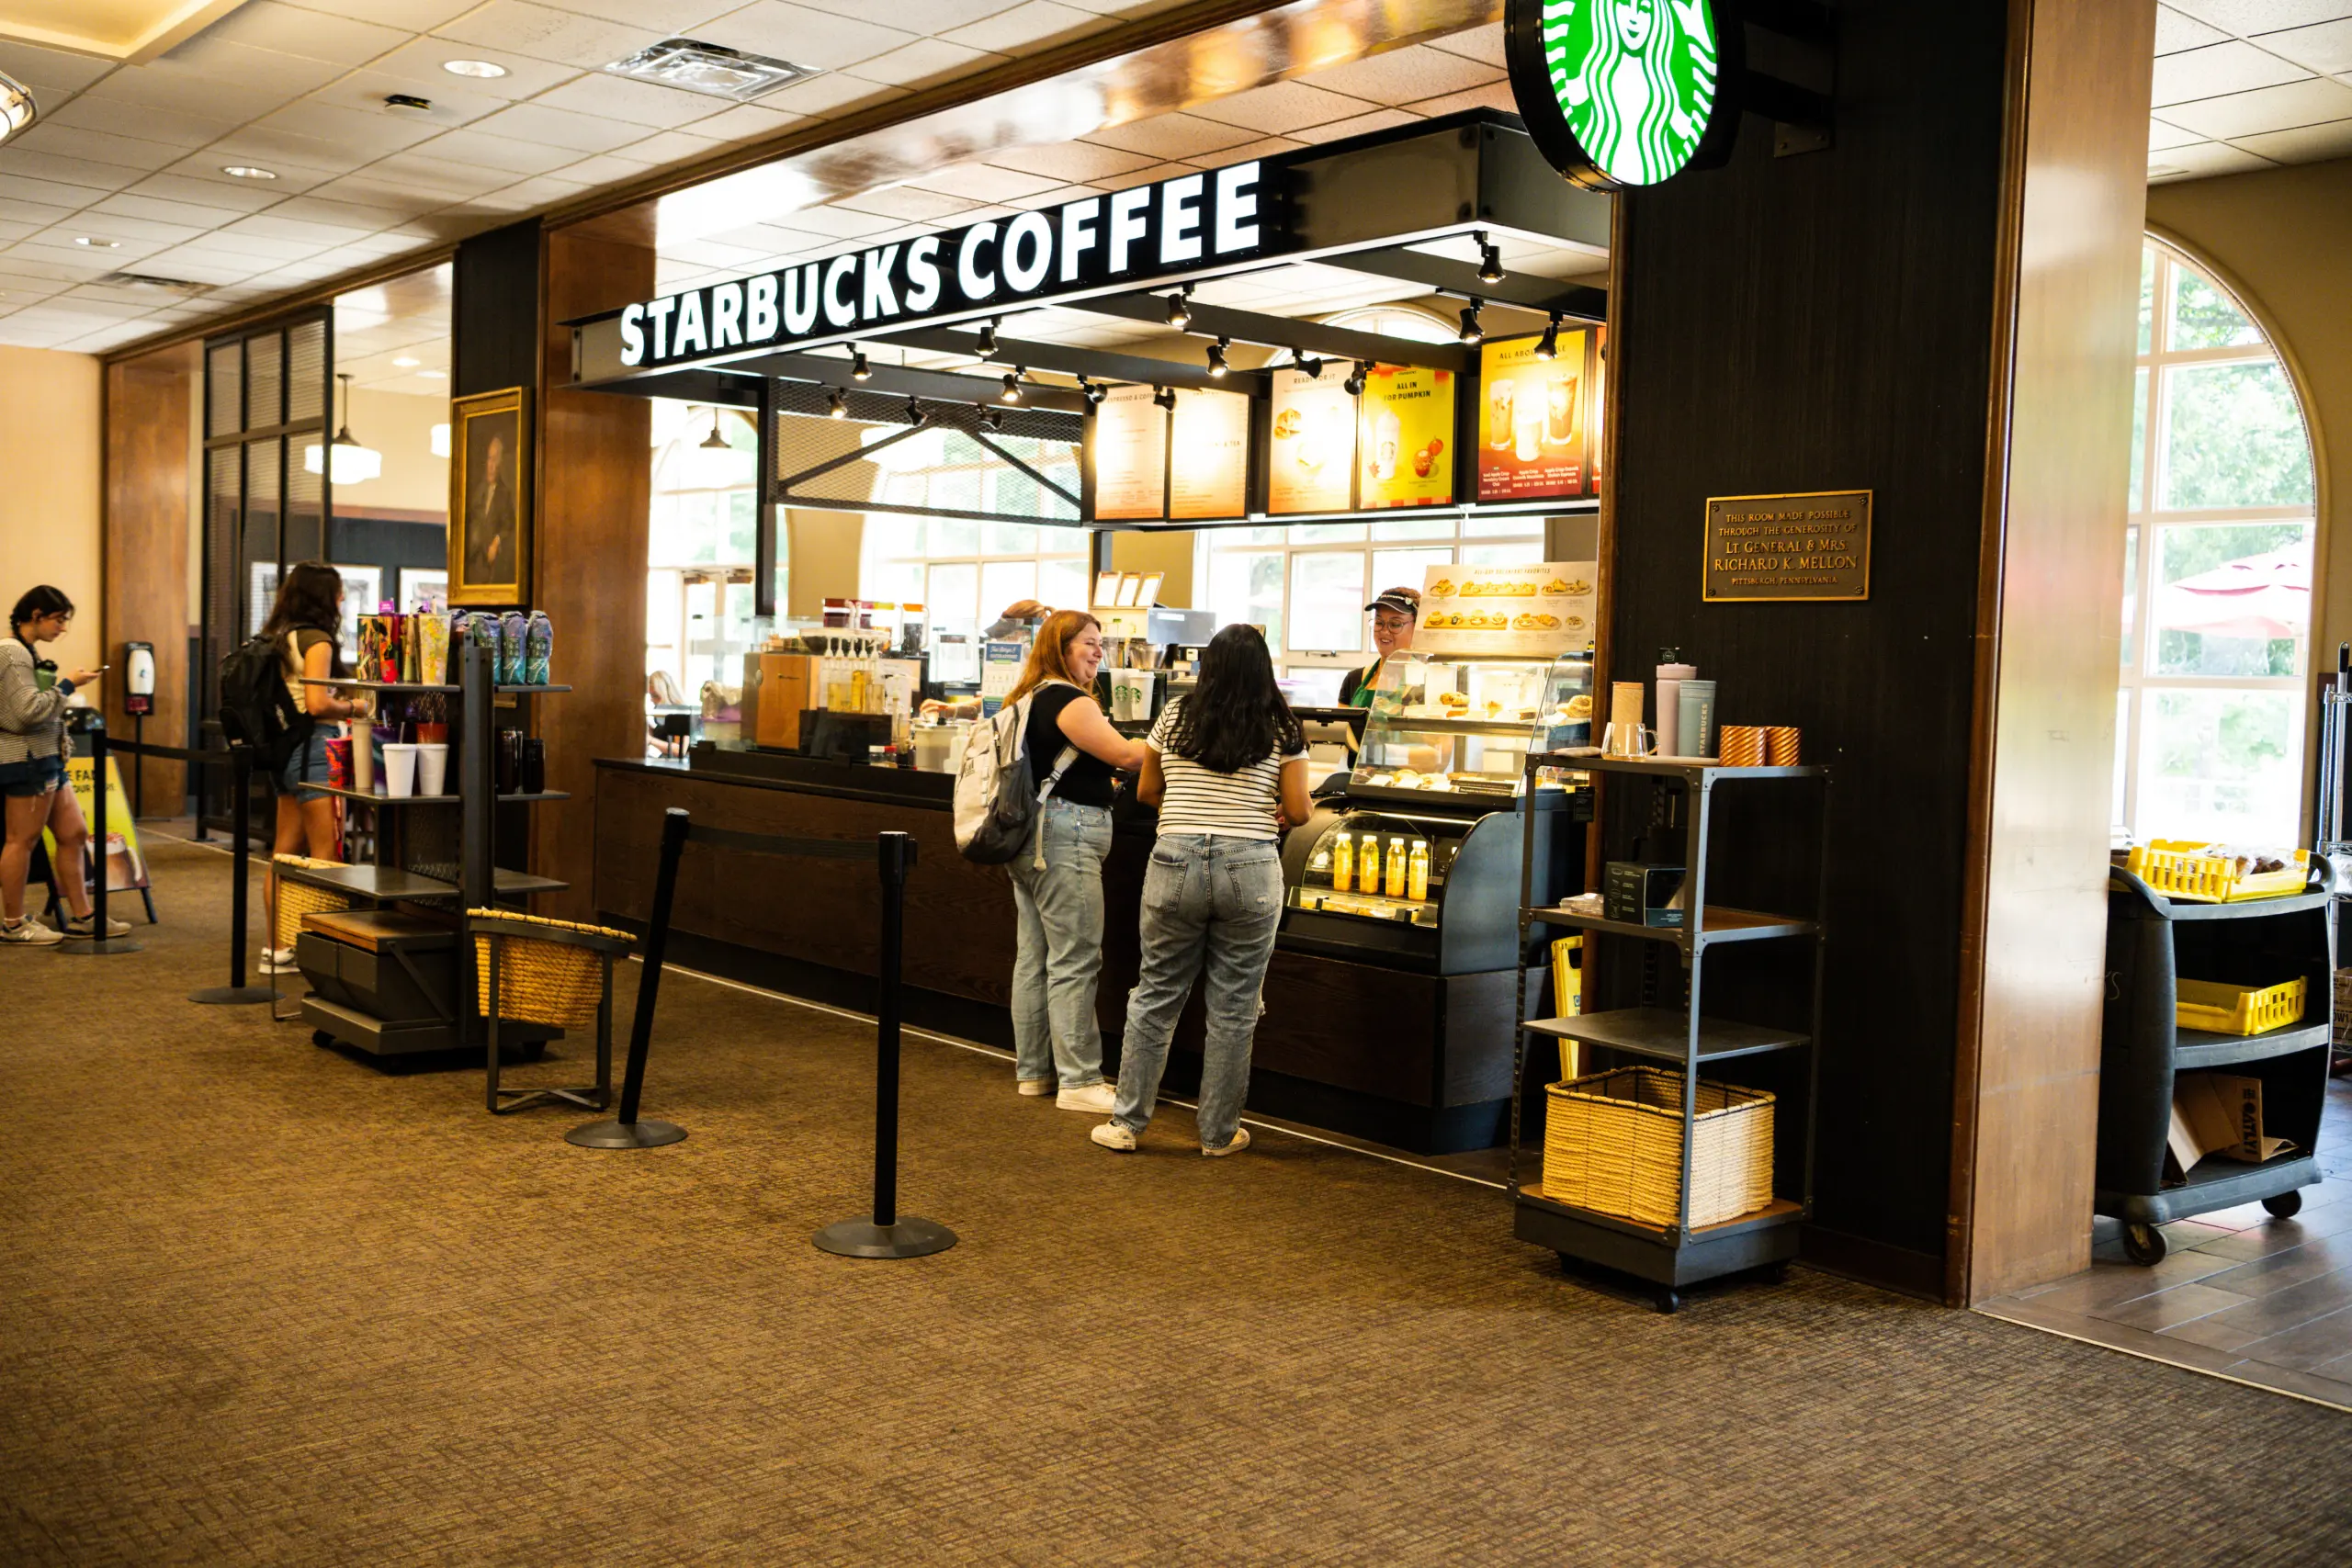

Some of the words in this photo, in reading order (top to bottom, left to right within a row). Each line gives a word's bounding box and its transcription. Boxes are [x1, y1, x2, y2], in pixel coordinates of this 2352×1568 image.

[619, 235, 941, 366] STARBUCKS
[957, 161, 1261, 300] COFFEE
[1398, 390, 1431, 400] PUMPKIN
[1725, 514, 1746, 523] THIS
[1748, 513, 1774, 522] ROOM
[1779, 512, 1804, 521] MADE
[1808, 510, 1850, 520] POSSIBLE
[1719, 527, 1759, 536] THROUGH
[1764, 526, 1780, 536] THE
[1783, 524, 1840, 535] GENEROSITY
[1845, 523, 1858, 533] OF
[1744, 540, 1803, 553] GENERAL
[1807, 539, 1815, 550] &
[1714, 558, 1779, 571] RICHARD
[1783, 558, 1795, 570] K.
[1799, 556, 1858, 570] MELLON
[1731, 577, 1779, 586] PITTSBURGH,
[1780, 576, 1838, 585] PENNSYLVANIA
[1699, 703, 1708, 755] STARBUCKS
